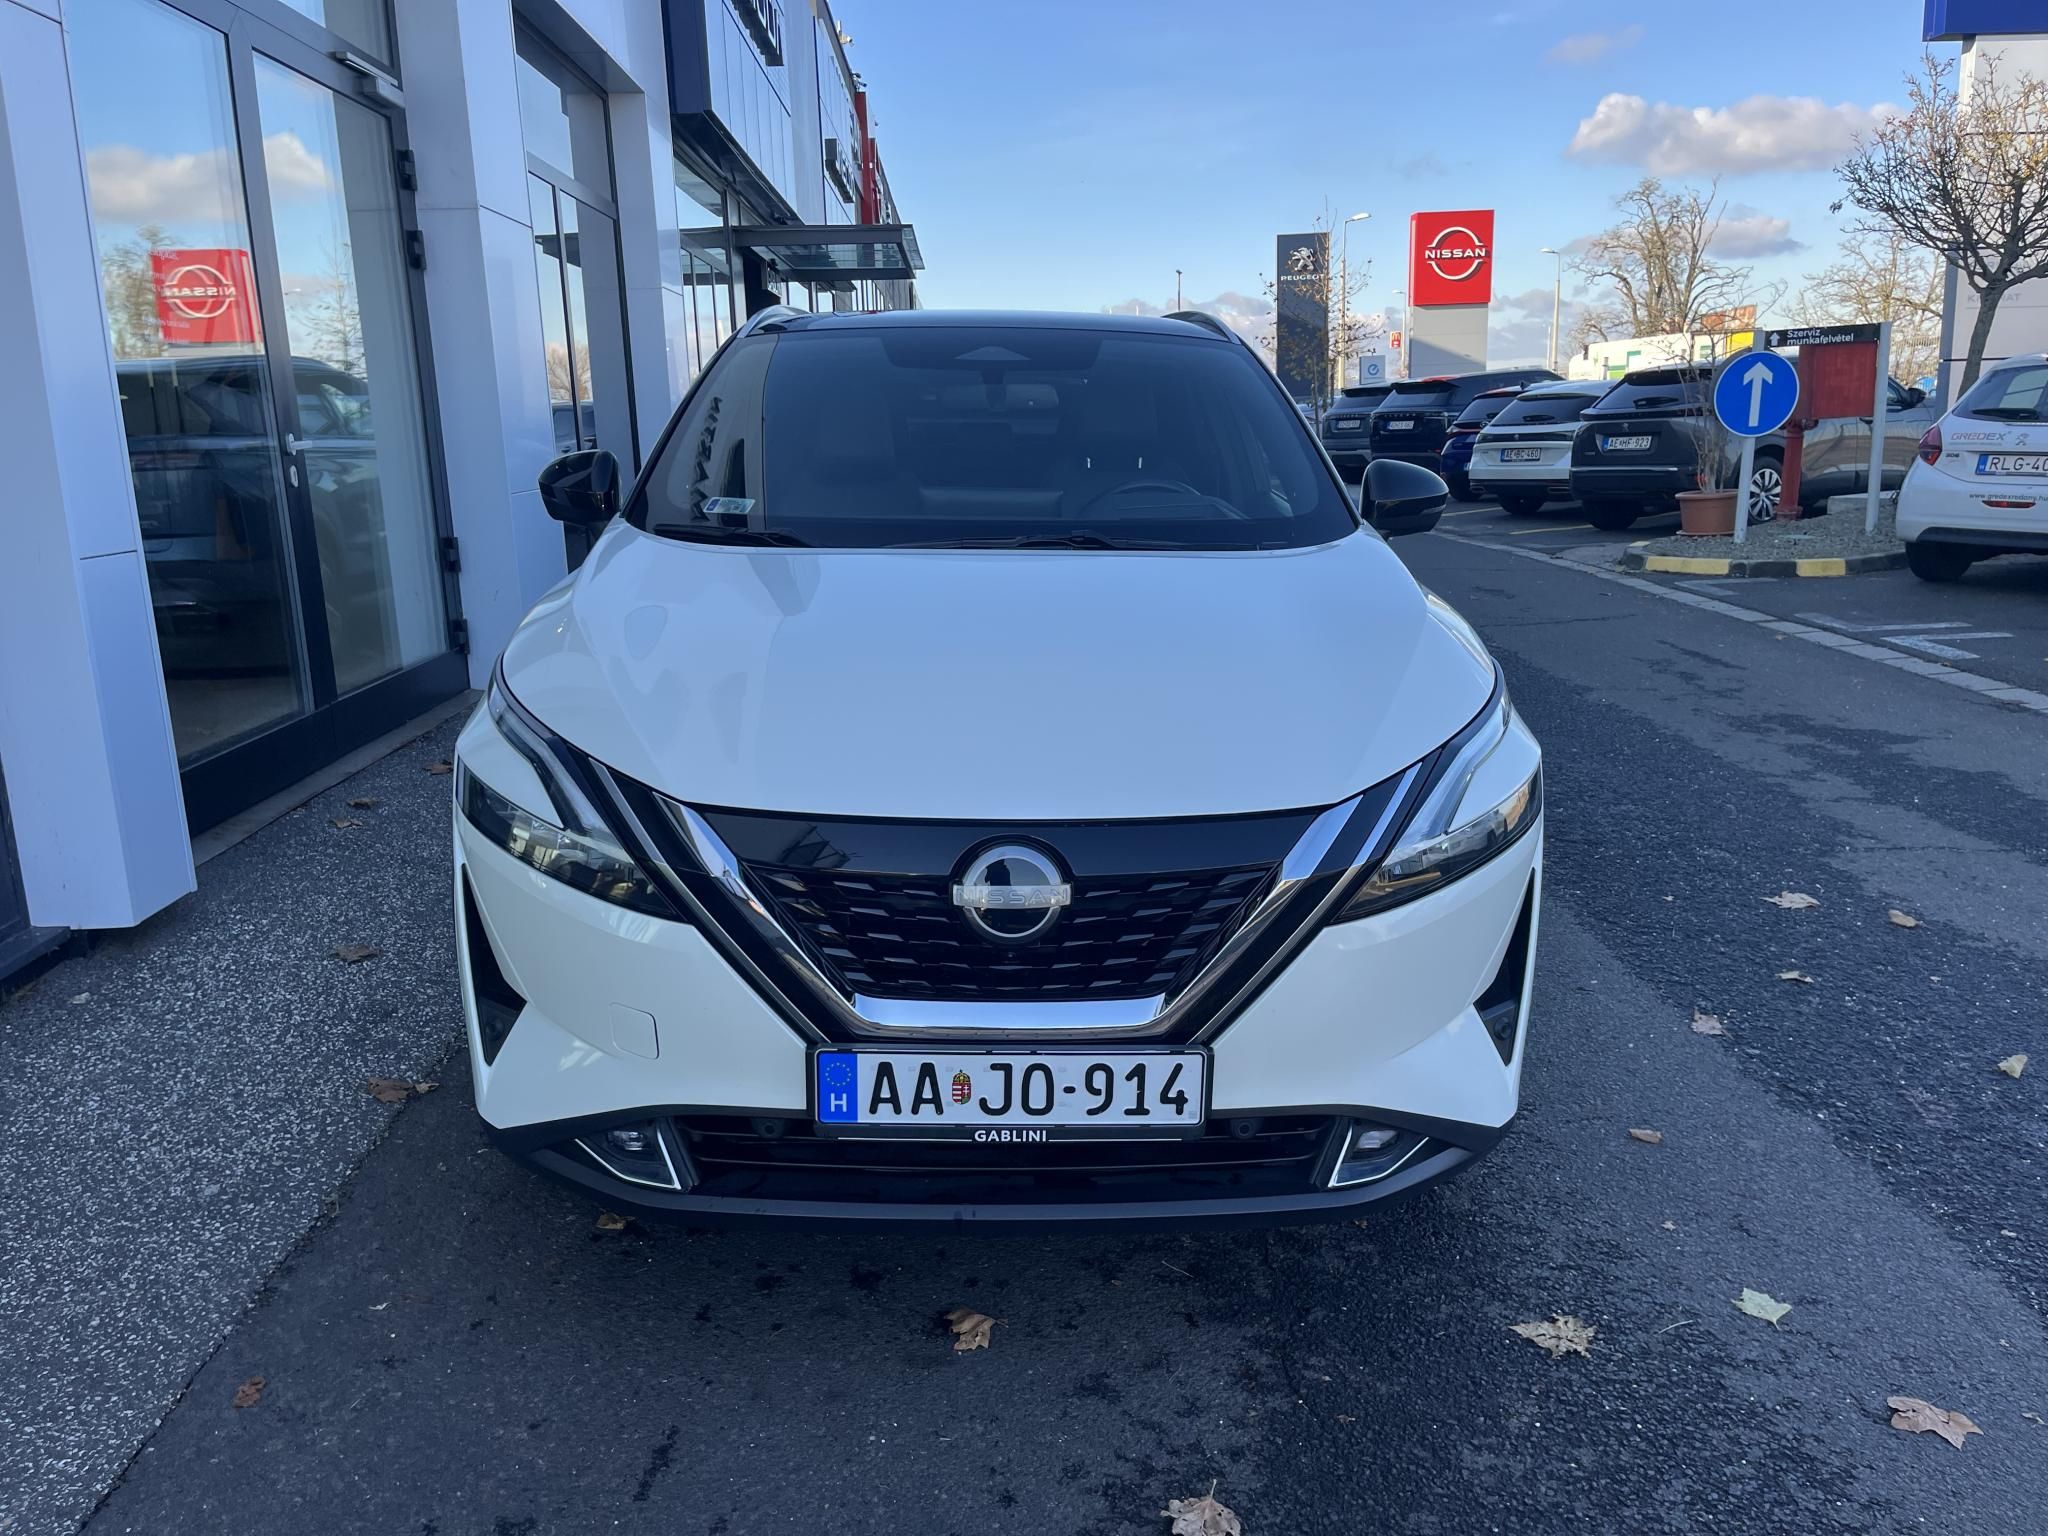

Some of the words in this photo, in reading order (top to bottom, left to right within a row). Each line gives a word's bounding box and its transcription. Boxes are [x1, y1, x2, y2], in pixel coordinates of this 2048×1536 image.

[1425, 248, 1486, 260] NISSAN
[1280, 273, 1325, 281] PEUGEOT
[1787, 328, 1821, 338] Szerviz
[1787, 333, 1854, 346] munkafelvétel
[1951, 432, 2006, 441] GREDEX
[956, 887, 1070, 904] NISSAN
[869, 1061, 944, 1115] AA
[979, 1061, 1189, 1116] JO-914
[830, 1093, 847, 1112] H
[974, 1130, 1047, 1143] GABLINI
